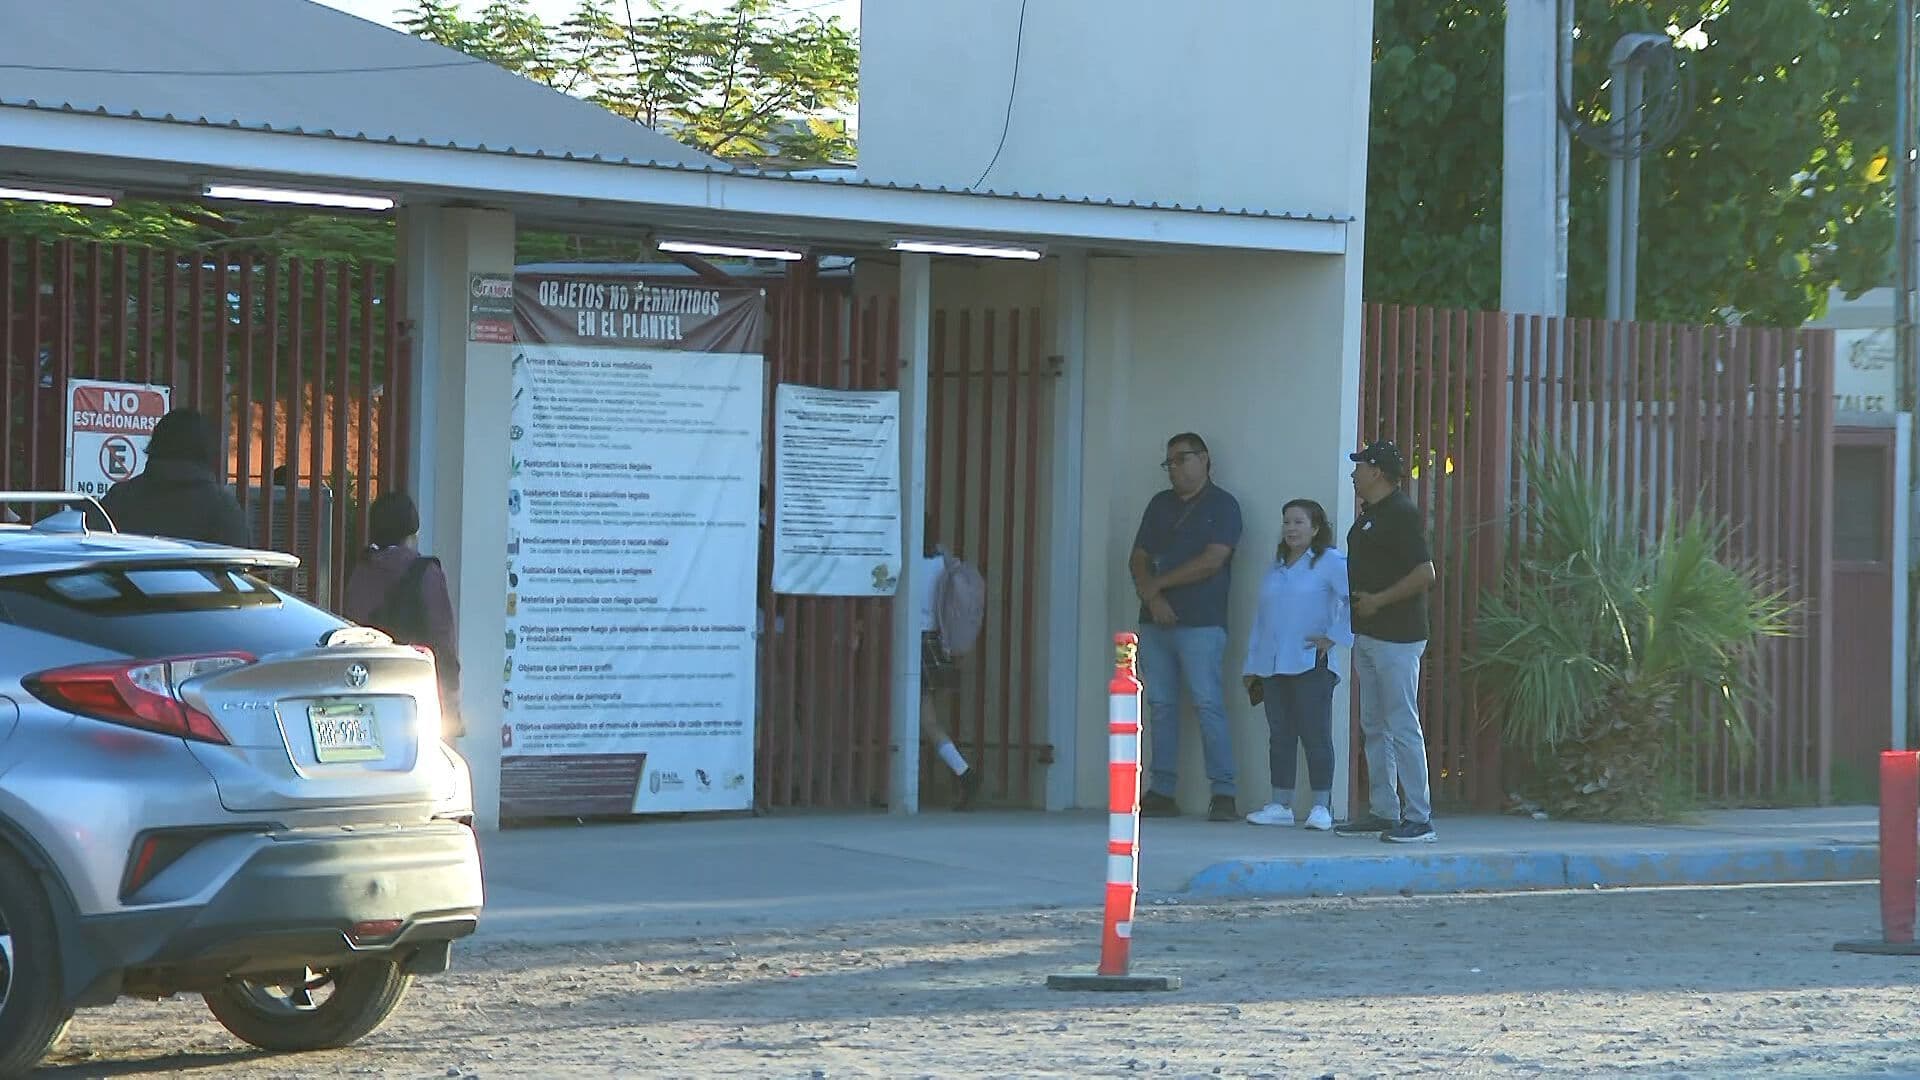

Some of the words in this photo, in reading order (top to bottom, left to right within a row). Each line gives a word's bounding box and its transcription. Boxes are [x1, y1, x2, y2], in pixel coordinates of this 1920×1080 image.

[539, 281, 604, 309] OBJETOS
[609, 285, 628, 311] NO
[634, 287, 720, 316] PERMITIDOS
[578, 311, 595, 336] EN
[602, 312, 617, 338] EL
[623, 313, 683, 340] PLANTEL
[103, 391, 139, 413] NO
[77, 481, 93, 494] NO
[518, 663, 543, 672] Objetos
[517, 693, 543, 701] Material
